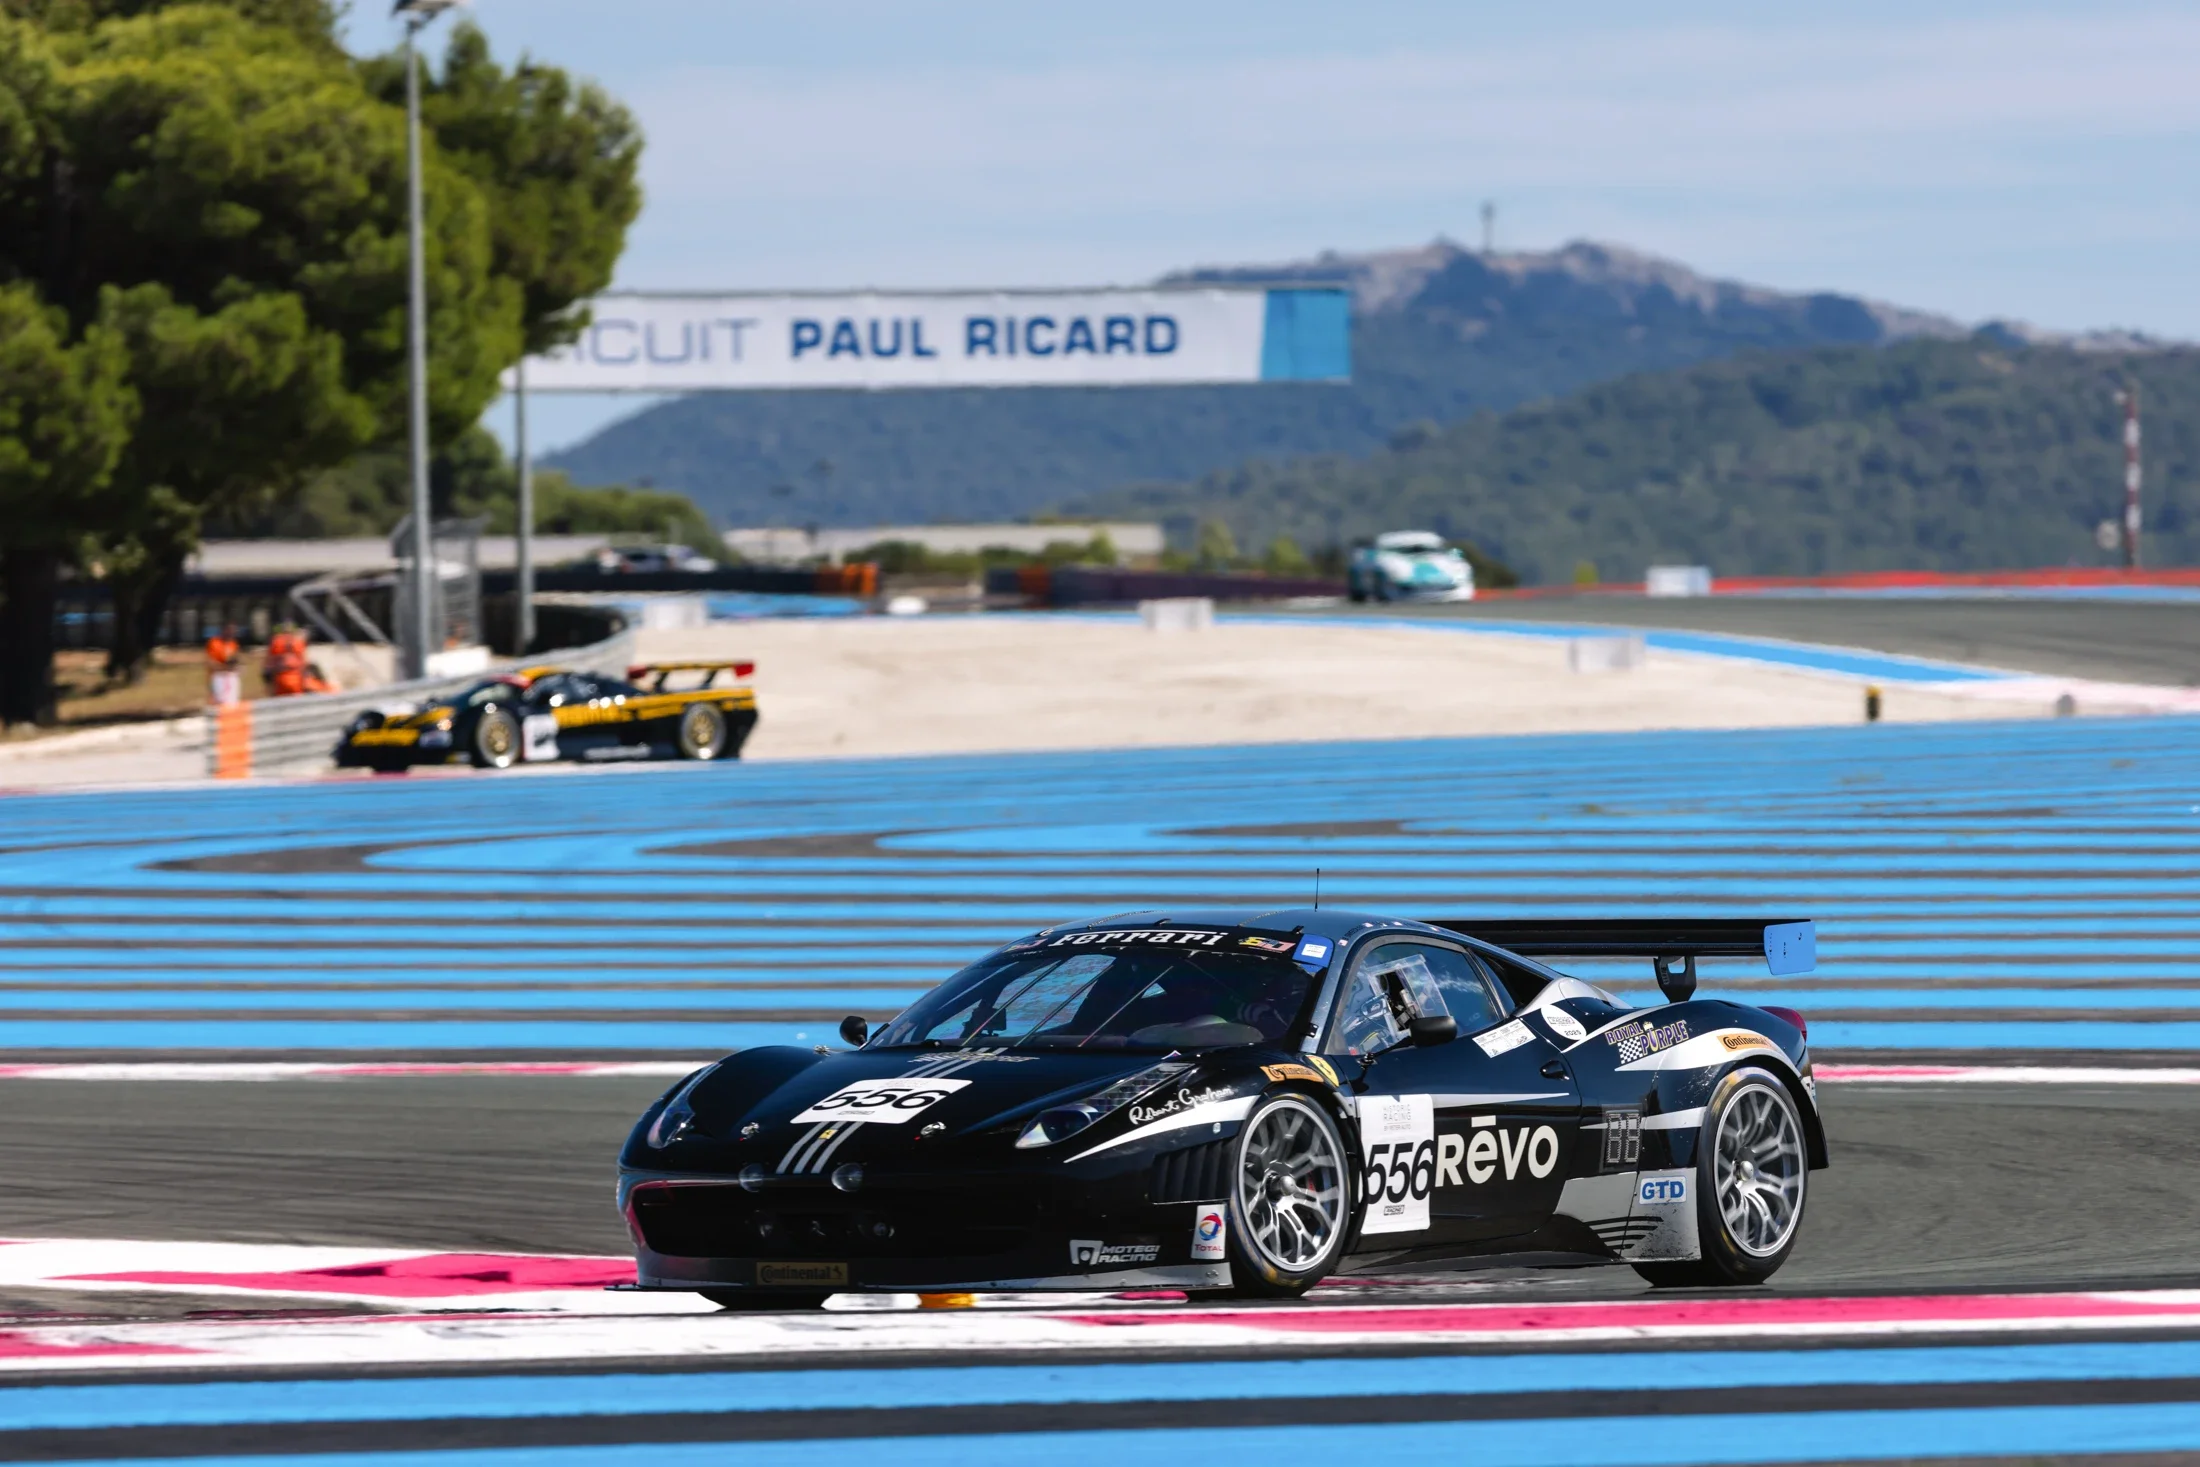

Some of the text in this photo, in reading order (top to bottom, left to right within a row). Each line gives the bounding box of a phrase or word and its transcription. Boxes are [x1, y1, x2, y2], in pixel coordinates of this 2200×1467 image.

[791, 318, 938, 358] PAUL
[965, 315, 1180, 356] RICARD
[1047, 929, 1229, 947] Ferrari
[1605, 1022, 1644, 1046] ROYAL
[1640, 1020, 1689, 1056] PURPLE
[812, 1088, 953, 1111] 556
[1366, 1139, 1435, 1205] 556
[1641, 1180, 1685, 1200] GTD
[1098, 1253, 1157, 1263] RACING
[1101, 1245, 1160, 1254] MOTEGI
[761, 1265, 832, 1283] Continental
